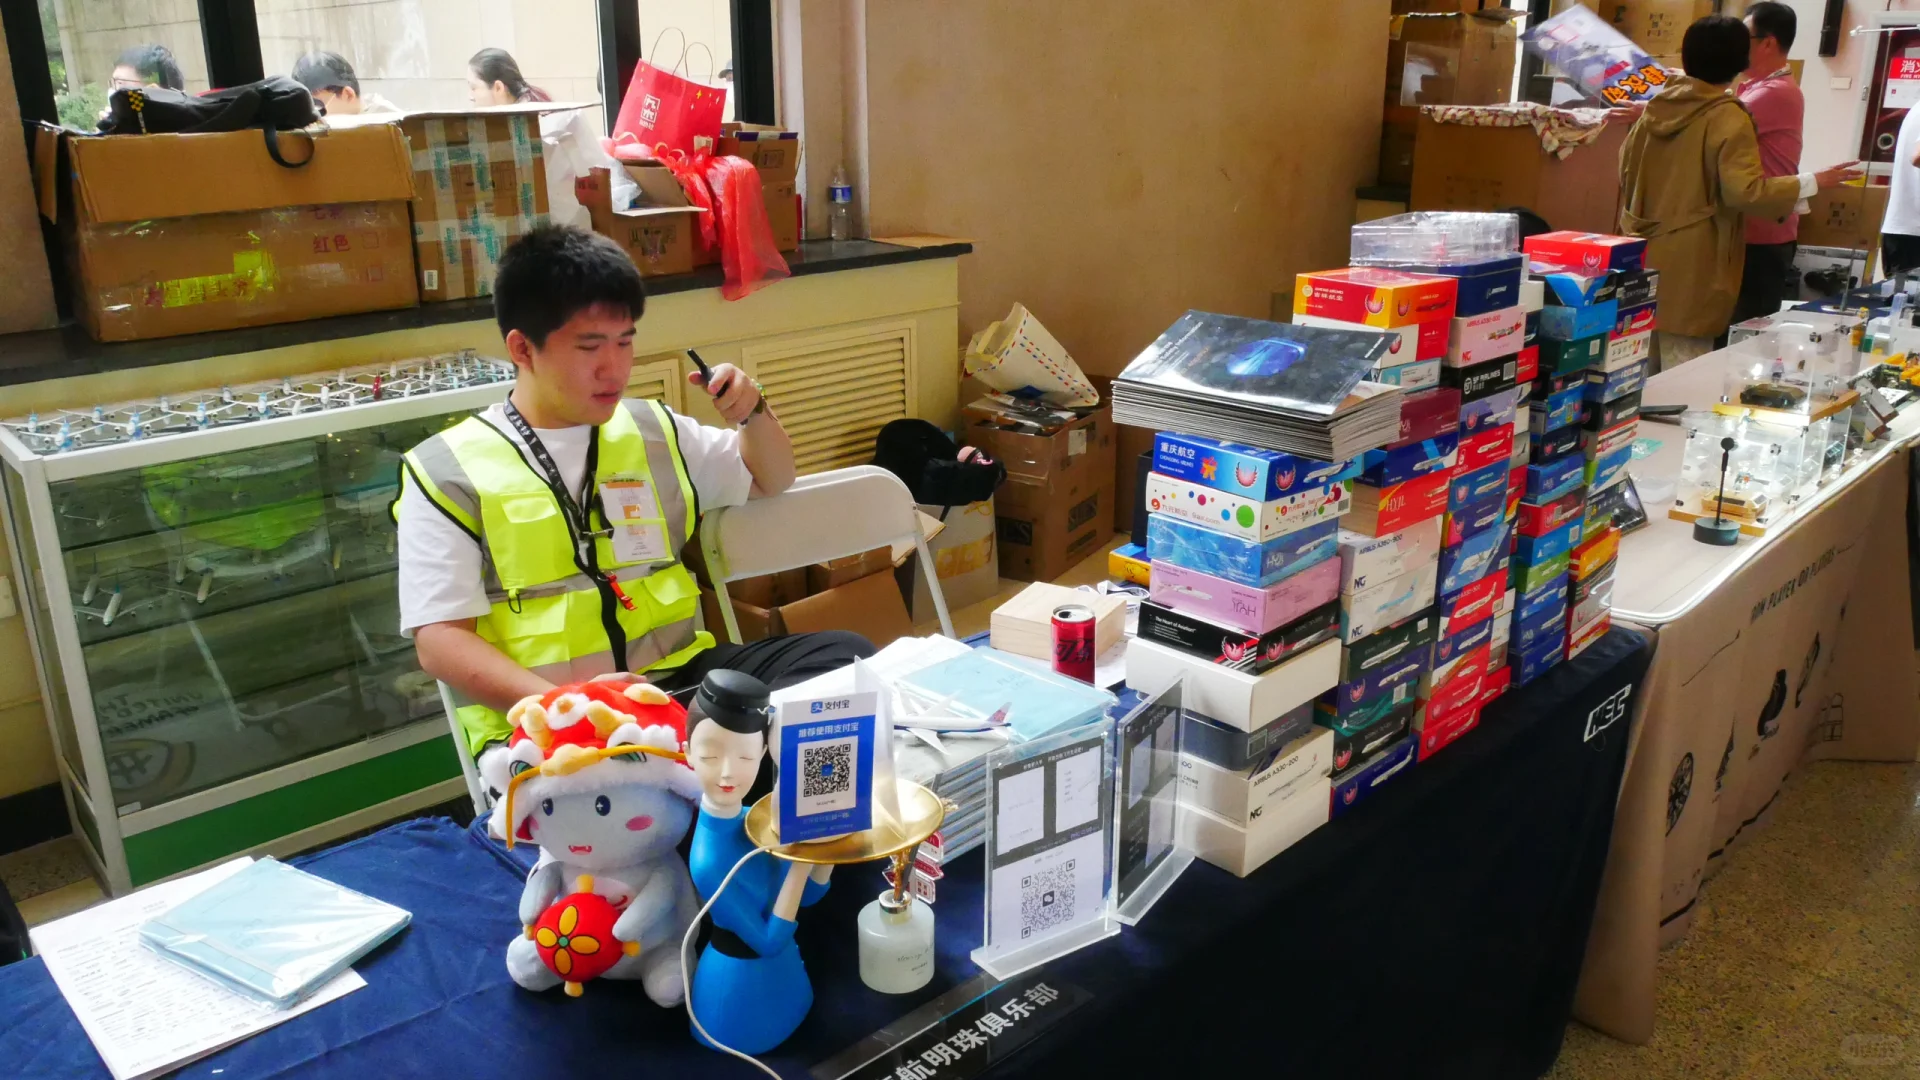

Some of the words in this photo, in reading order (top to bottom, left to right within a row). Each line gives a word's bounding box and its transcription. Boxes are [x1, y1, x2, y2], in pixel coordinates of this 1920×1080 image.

[312, 234, 350, 254] 红色
[1160, 441, 1195, 460] 重庆航空
[1359, 544, 1376, 555] AIRBUS
[1163, 617, 1173, 625] Heart
[824, 700, 850, 712] 支付宝
[798, 722, 860, 739] 推荐使用支付宝
[1253, 772, 1272, 787] AIRBUS
[1272, 755, 1299, 777] A330-200
